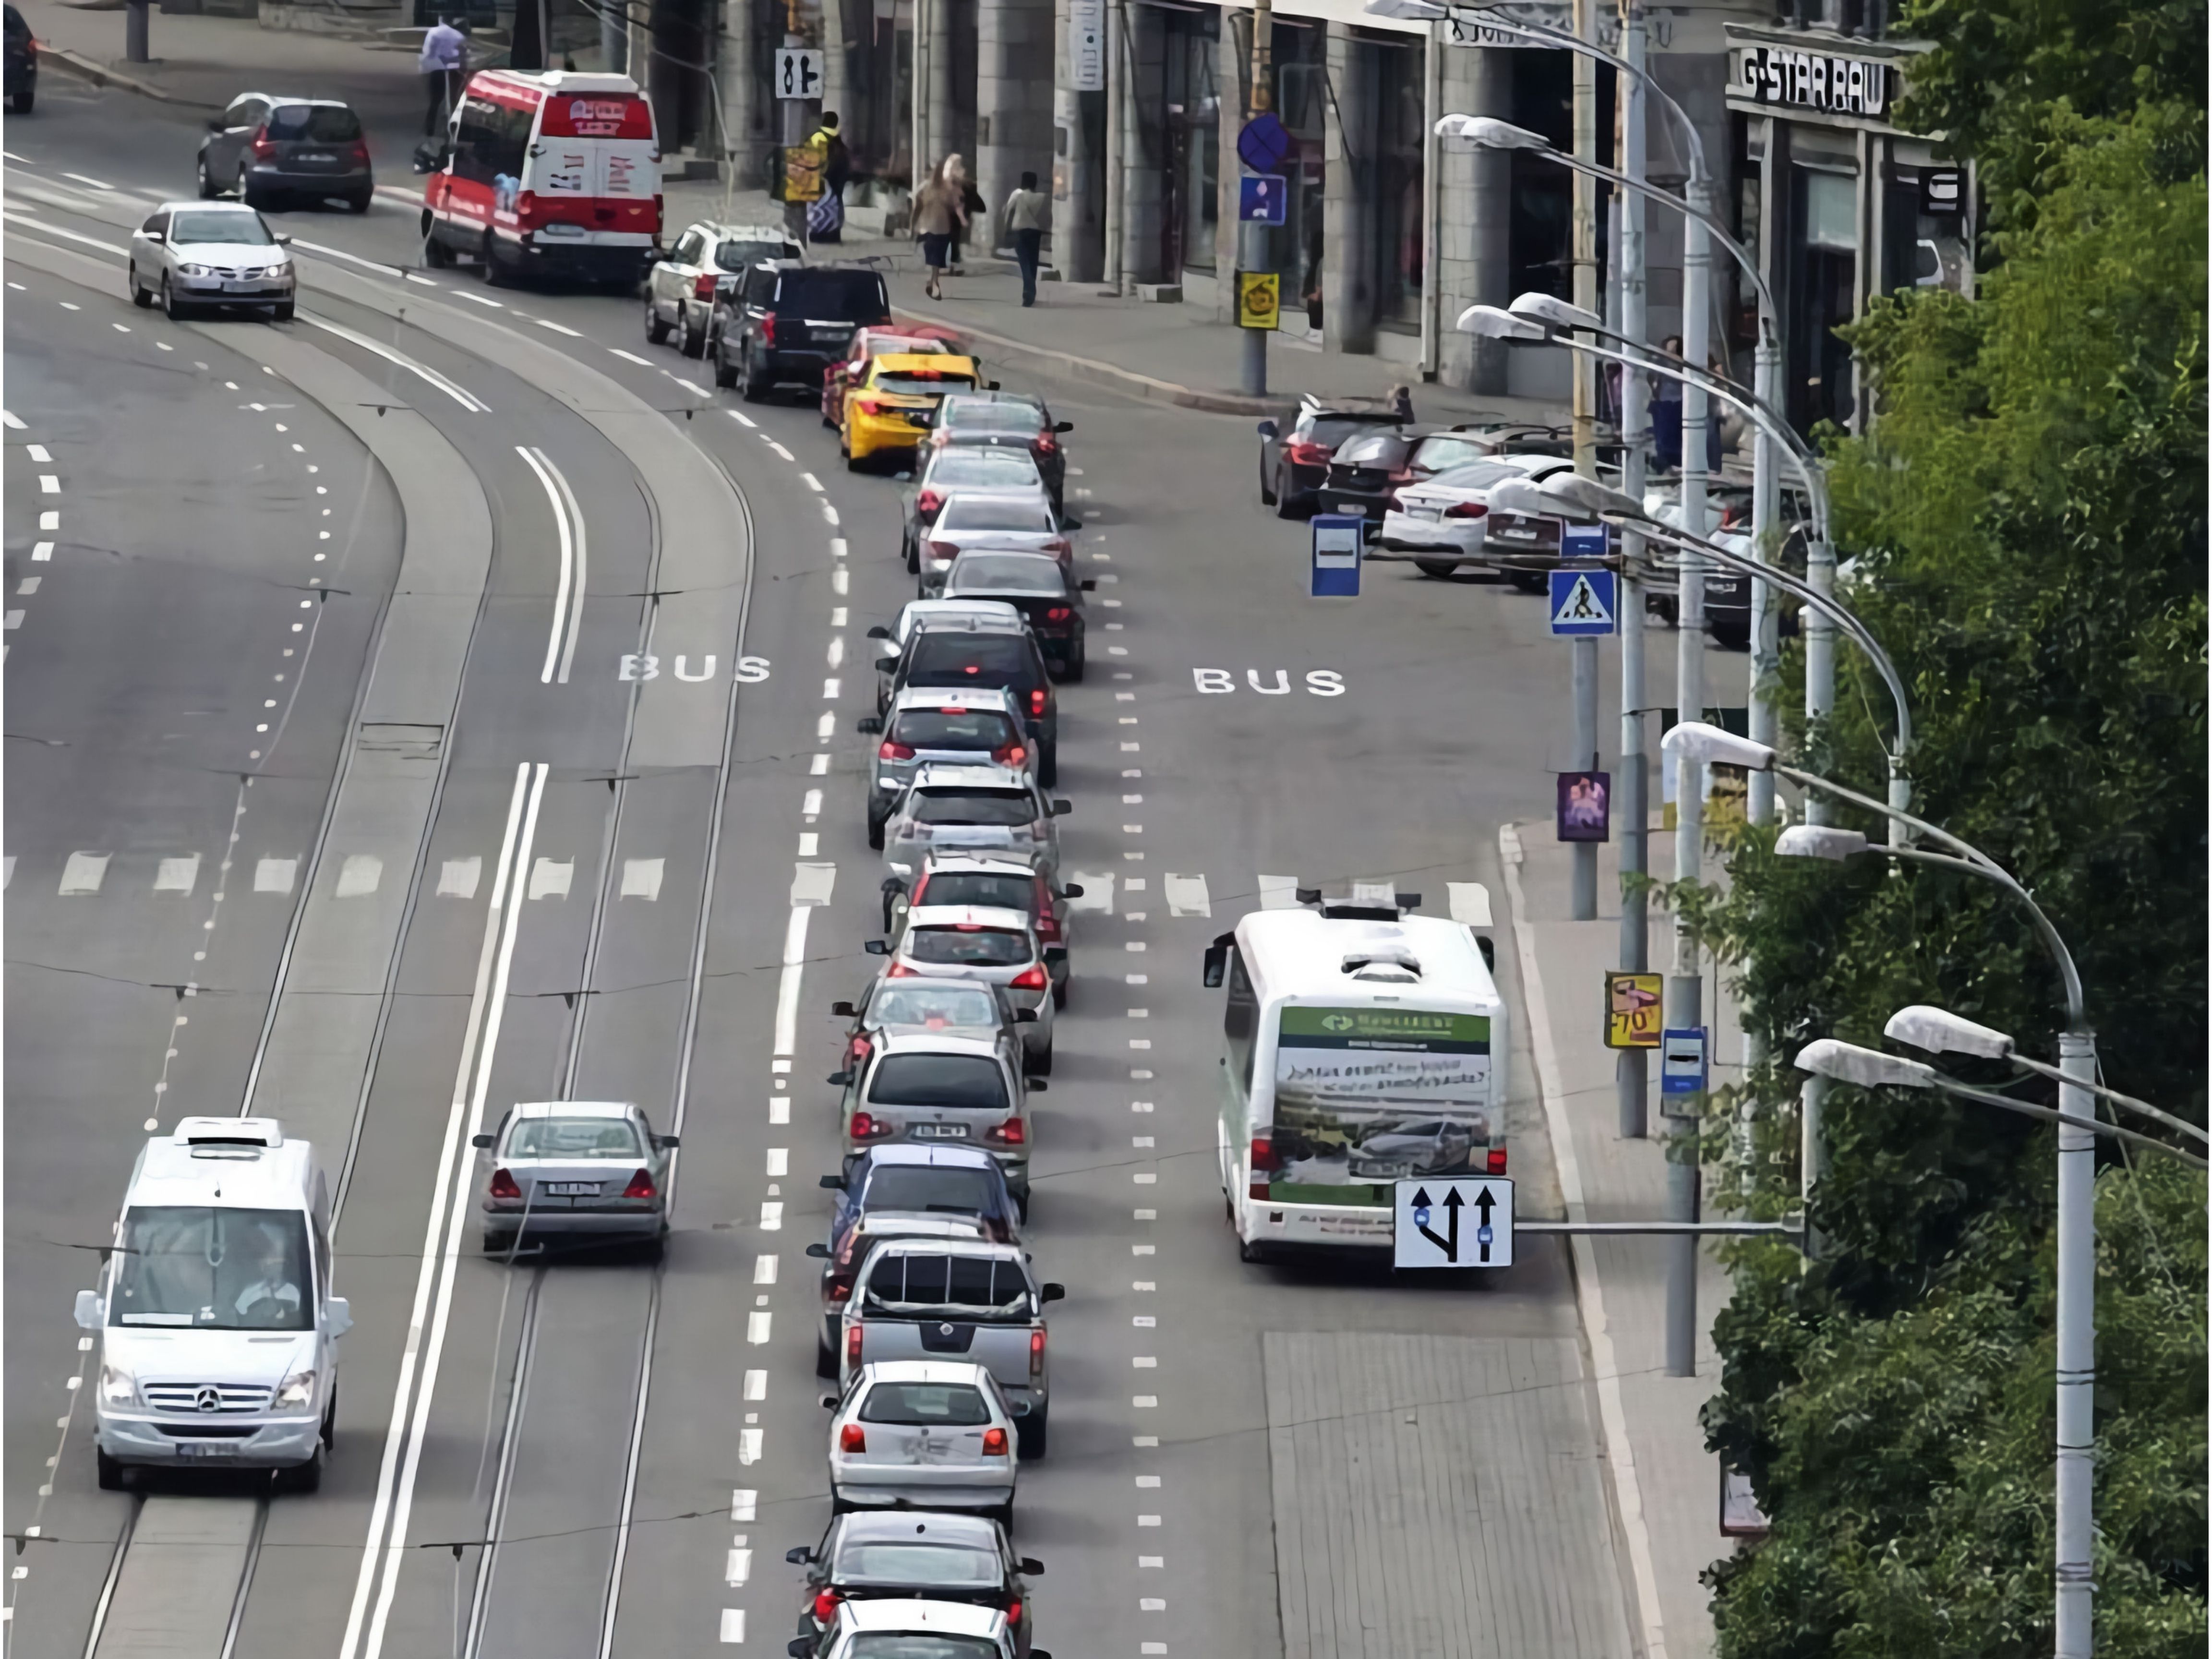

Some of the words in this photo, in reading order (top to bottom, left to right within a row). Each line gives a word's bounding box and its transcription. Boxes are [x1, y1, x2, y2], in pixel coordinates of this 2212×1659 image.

[1740, 48, 1827, 107] G-STAR
[1832, 57, 1885, 114] RAW
[618, 654, 770, 683] BUS
[1193, 668, 1345, 696] BUS
